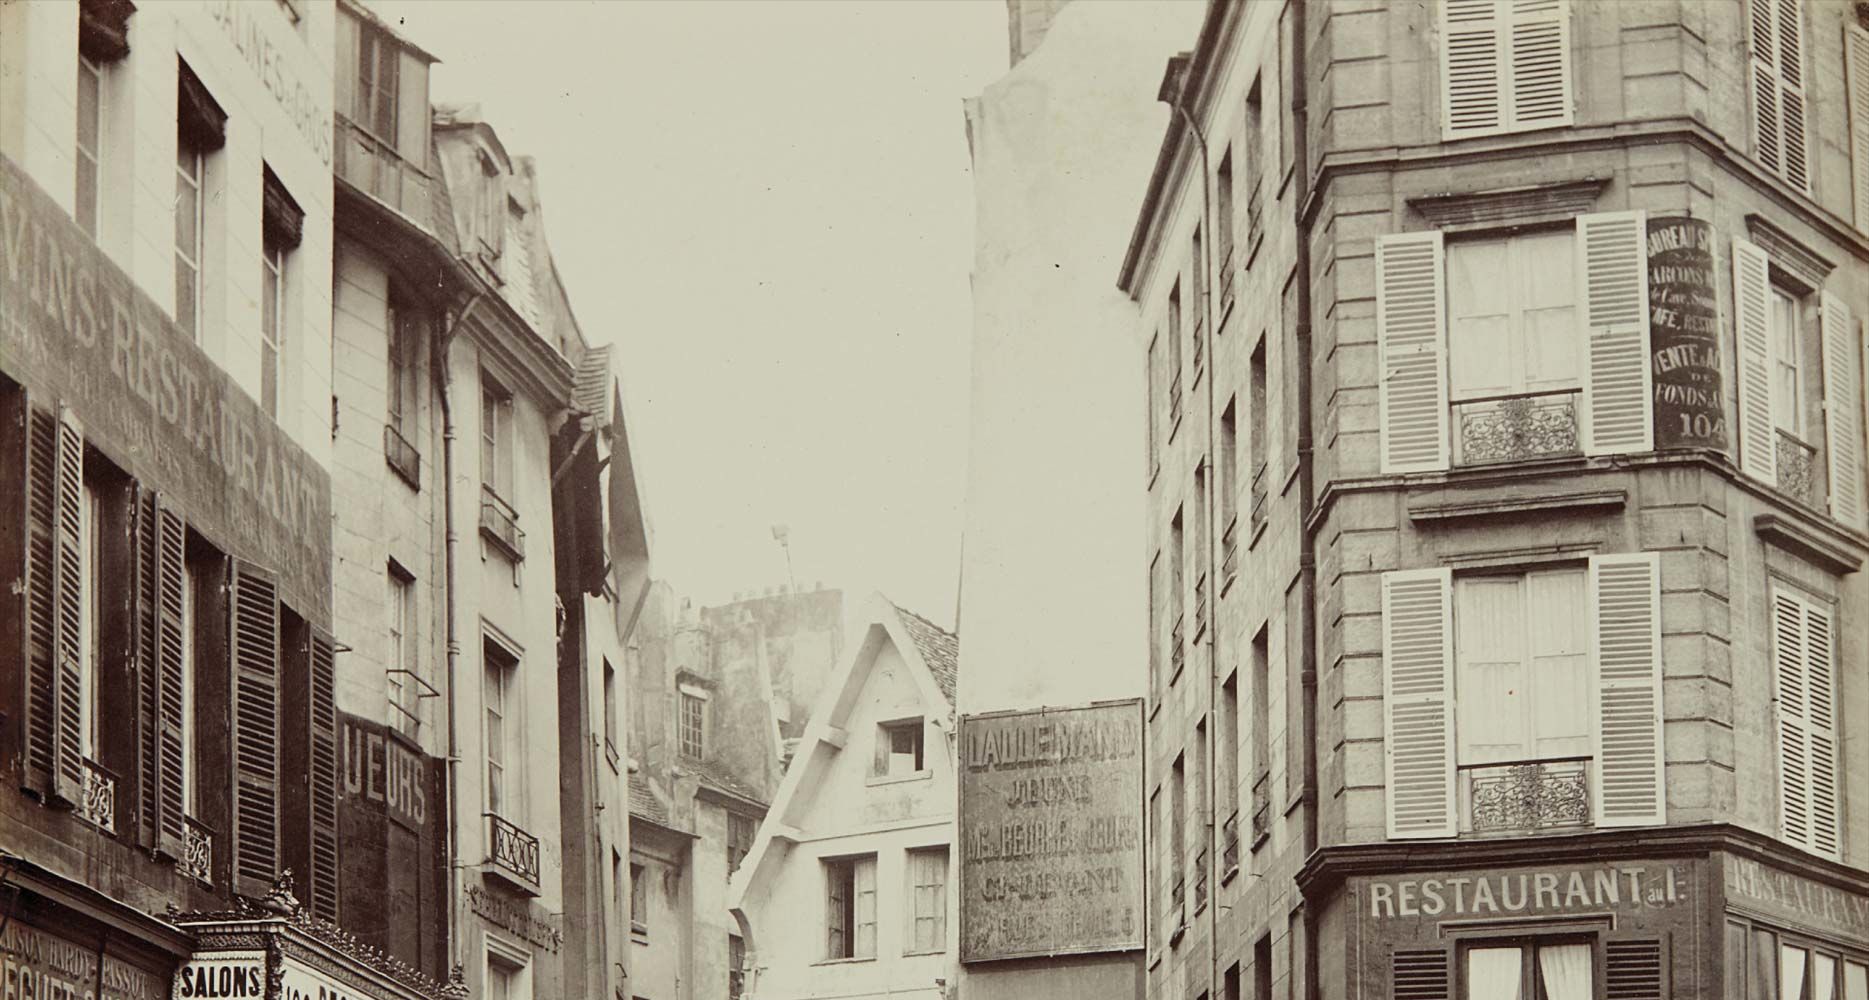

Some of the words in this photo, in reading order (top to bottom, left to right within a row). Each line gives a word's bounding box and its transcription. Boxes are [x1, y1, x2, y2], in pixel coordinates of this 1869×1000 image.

[110, 295, 318, 550] RESTAURANT
[1370, 866, 1646, 919] RESTAURANT
[1733, 857, 1869, 927] RESTAURAN
[181, 965, 260, 999] SALONS
